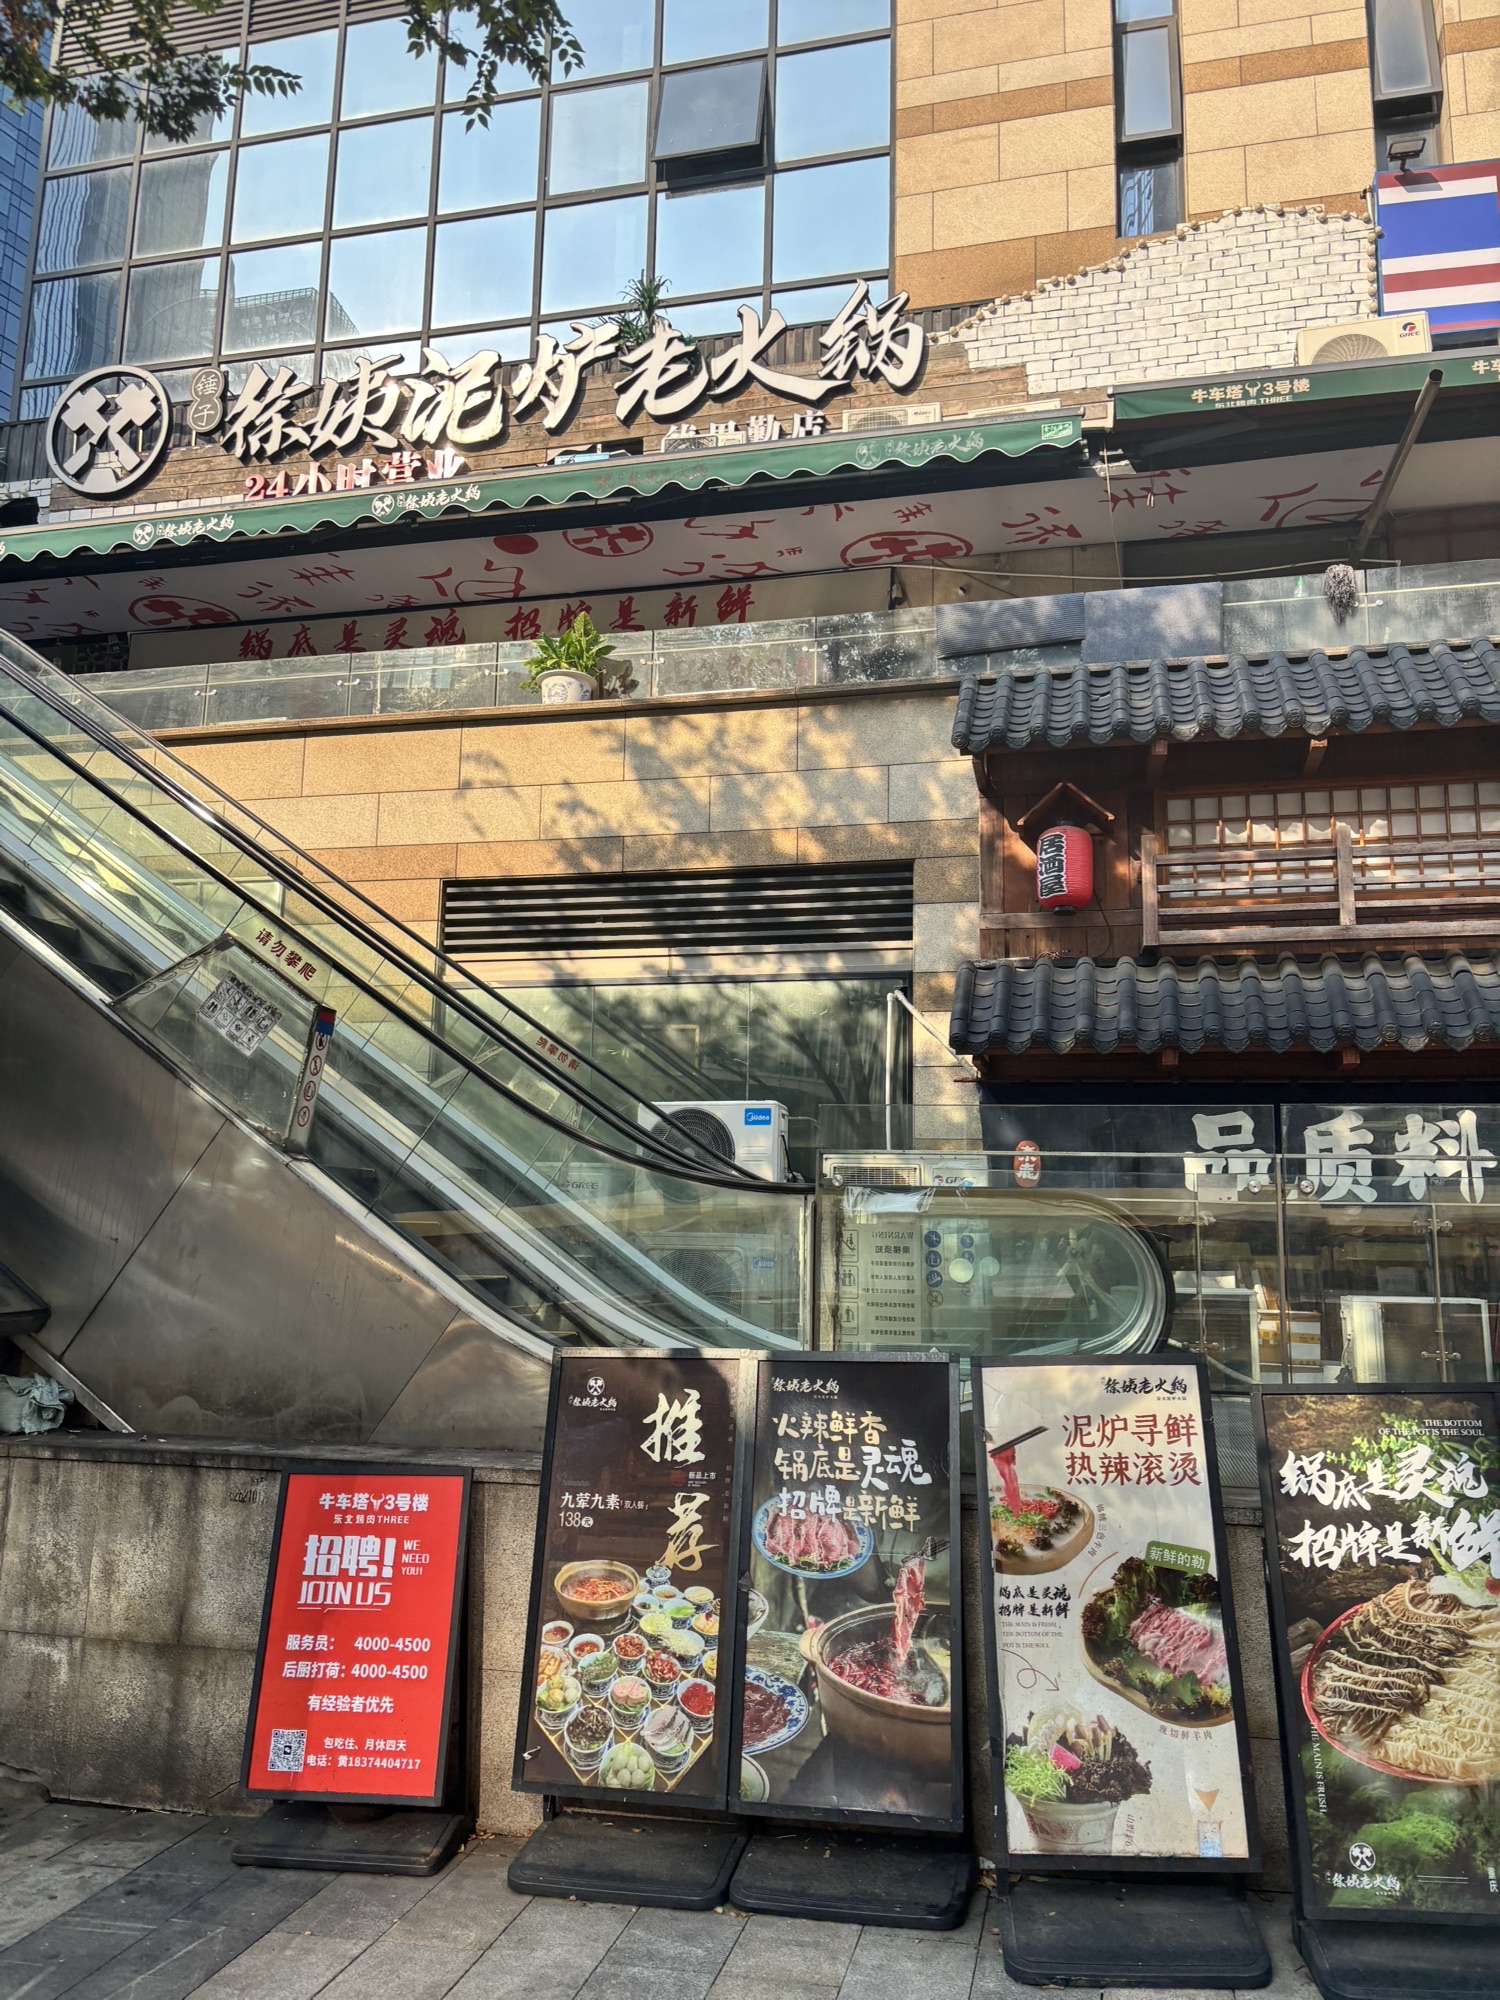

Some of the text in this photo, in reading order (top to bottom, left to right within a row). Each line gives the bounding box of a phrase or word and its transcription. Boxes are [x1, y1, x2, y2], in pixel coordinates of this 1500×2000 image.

[219, 278, 926, 460] 徐姨泥炉老火锅
[188, 372, 219, 428] 锤子
[1191, 379, 1311, 404] 牛车塔 3号楼
[1259, 395, 1293, 405] THREE
[244, 447, 466, 500] 24小时营业
[404, 483, 481, 511] 徐姨老火锅
[164, 513, 235, 538] 徐姨老火锅
[238, 608, 467, 660] 锅底是灵魂
[1038, 832, 1068, 899] 居酒屋
[255, 928, 317, 981] 请勿攀爬
[747, 1113, 770, 1122] Midea
[1183, 1109, 1498, 1204] 品质料
[571, 1181, 598, 1190] GREE
[1104, 1376, 1187, 1395] 徐姨老火锅
[772, 1410, 888, 1445] 火辣鲜香
[1062, 1413, 1198, 1448] 泥炉寻鲜
[1423, 1419, 1482, 1427] THE BOTTOM
[1461, 1428, 1485, 1436] SOUL
[688, 1471, 717, 1480] 新品上市
[773, 1439, 932, 1491] 锅底是灵魂
[1065, 1451, 1202, 1487] 热辣滚烫
[1279, 1442, 1489, 1511] 锅底是灵魂
[319, 1493, 429, 1512] 牛车塔 3号楼
[560, 1492, 620, 1510] 九荤九素
[777, 1485, 921, 1533] 招牌是新鲜
[377, 1516, 410, 1525] THREE
[403, 1540, 421, 1551] WE
[1288, 1507, 1500, 1579] 招牌是新鲜
[401, 1553, 430, 1564] NEED
[1149, 1547, 1206, 1571] 新鲜的勒
[401, 1566, 423, 1576] YOU!
[297, 1581, 392, 1606] JOIN US
[999, 1584, 1071, 1602] 锅底是灵魂
[998, 1602, 1070, 1619] 招牌是新鲜
[354, 1637, 431, 1652] 4000-4500
[307, 1694, 394, 1713] 有经验者优先
[323, 1737, 407, 1752] 包吃住、月休四天
[1312, 1742, 1322, 1769] MAIN
[1316, 1771, 1324, 1780] IS
